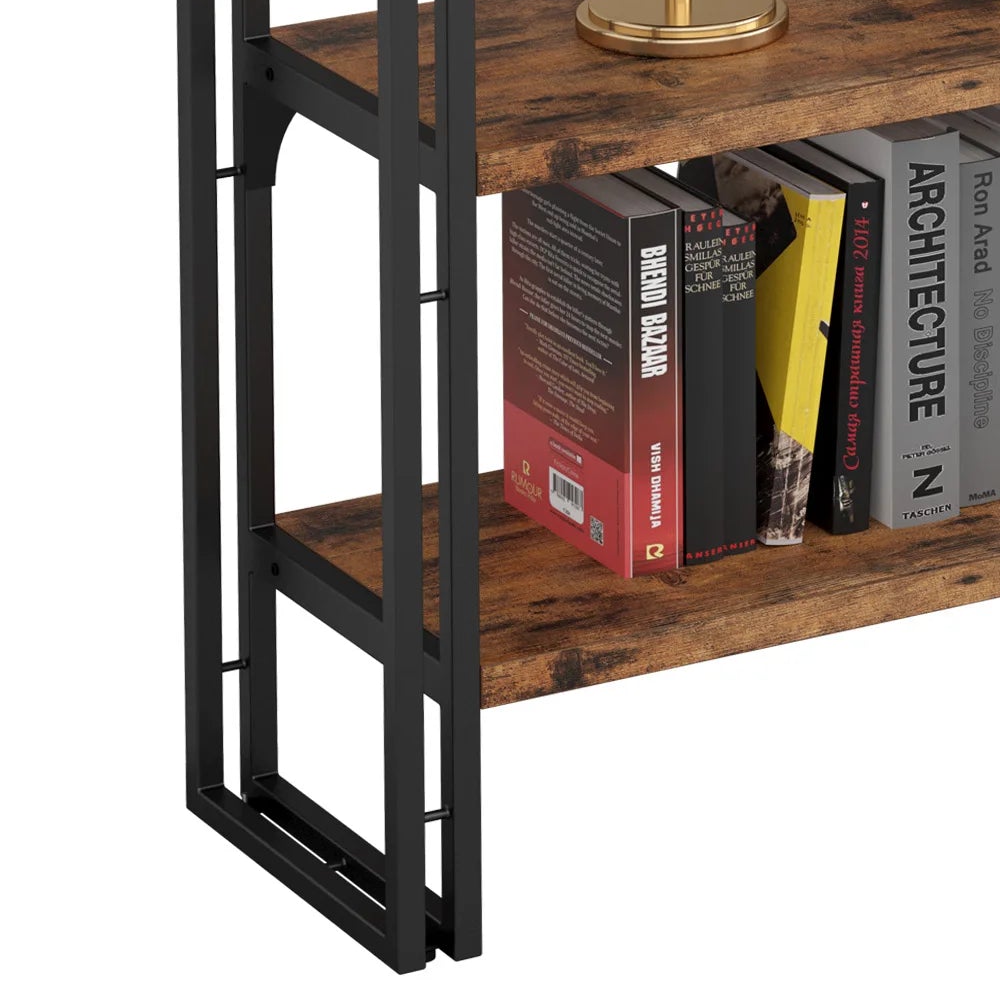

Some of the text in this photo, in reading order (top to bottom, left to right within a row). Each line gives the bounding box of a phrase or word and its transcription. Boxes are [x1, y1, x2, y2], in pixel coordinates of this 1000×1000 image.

[690, 208, 724, 223] ETER
[725, 222, 756, 237] ETER
[684, 258, 721, 273] GESPÜR
[695, 270, 714, 282] FÜR
[684, 280, 721, 294] SCHNEE
[729, 281, 747, 292] FÜR
[908, 162, 946, 422] ARCHITECTURE
[969, 171, 994, 429] Ron Arad No Discipline
[640, 244, 668, 379] BHENDI BAZAAR
[842, 216, 870, 471] Самая страшная книга 2014
[649, 442, 662, 529] VISH DHAMIJA
[968, 489, 997, 502] MoMA
[902, 503, 952, 520] TASCHEN
[686, 546, 723, 559] ANSER
